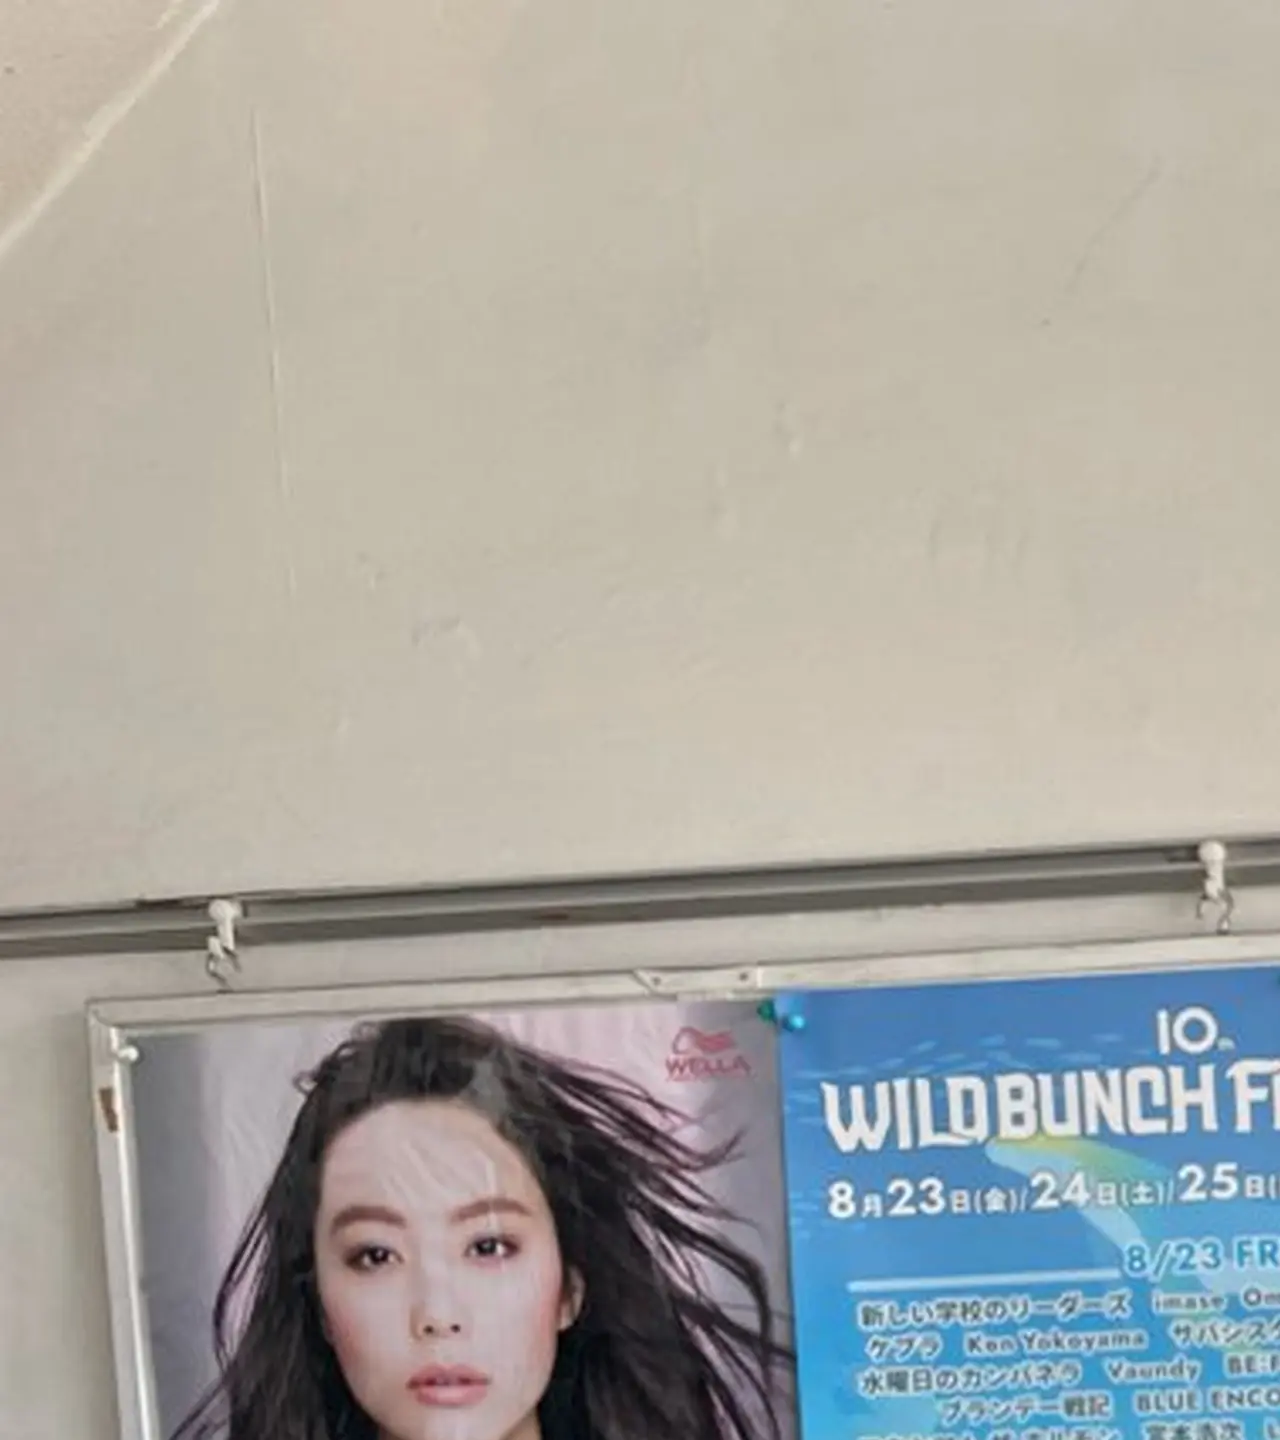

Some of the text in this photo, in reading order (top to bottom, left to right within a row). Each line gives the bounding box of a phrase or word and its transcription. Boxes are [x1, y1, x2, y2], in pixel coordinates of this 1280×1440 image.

[821, 1076, 988, 1153] WILD
[995, 1064, 1218, 1140] BUNCH
[1125, 1241, 1223, 1278] 8/23
[860, 1291, 1131, 1328] 新しい学校のリーダーズ
[1154, 1292, 1225, 1315] imase
[967, 1331, 1015, 1355] Ken
[1020, 1329, 1145, 1356] Yokoyama
[860, 1359, 1080, 1396] 水曜日のカンパネラ
[1108, 1354, 1202, 1383] Vaundy
[942, 1391, 1110, 1425] ブランデー戦記
[1135, 1390, 1200, 1414] BLUE
